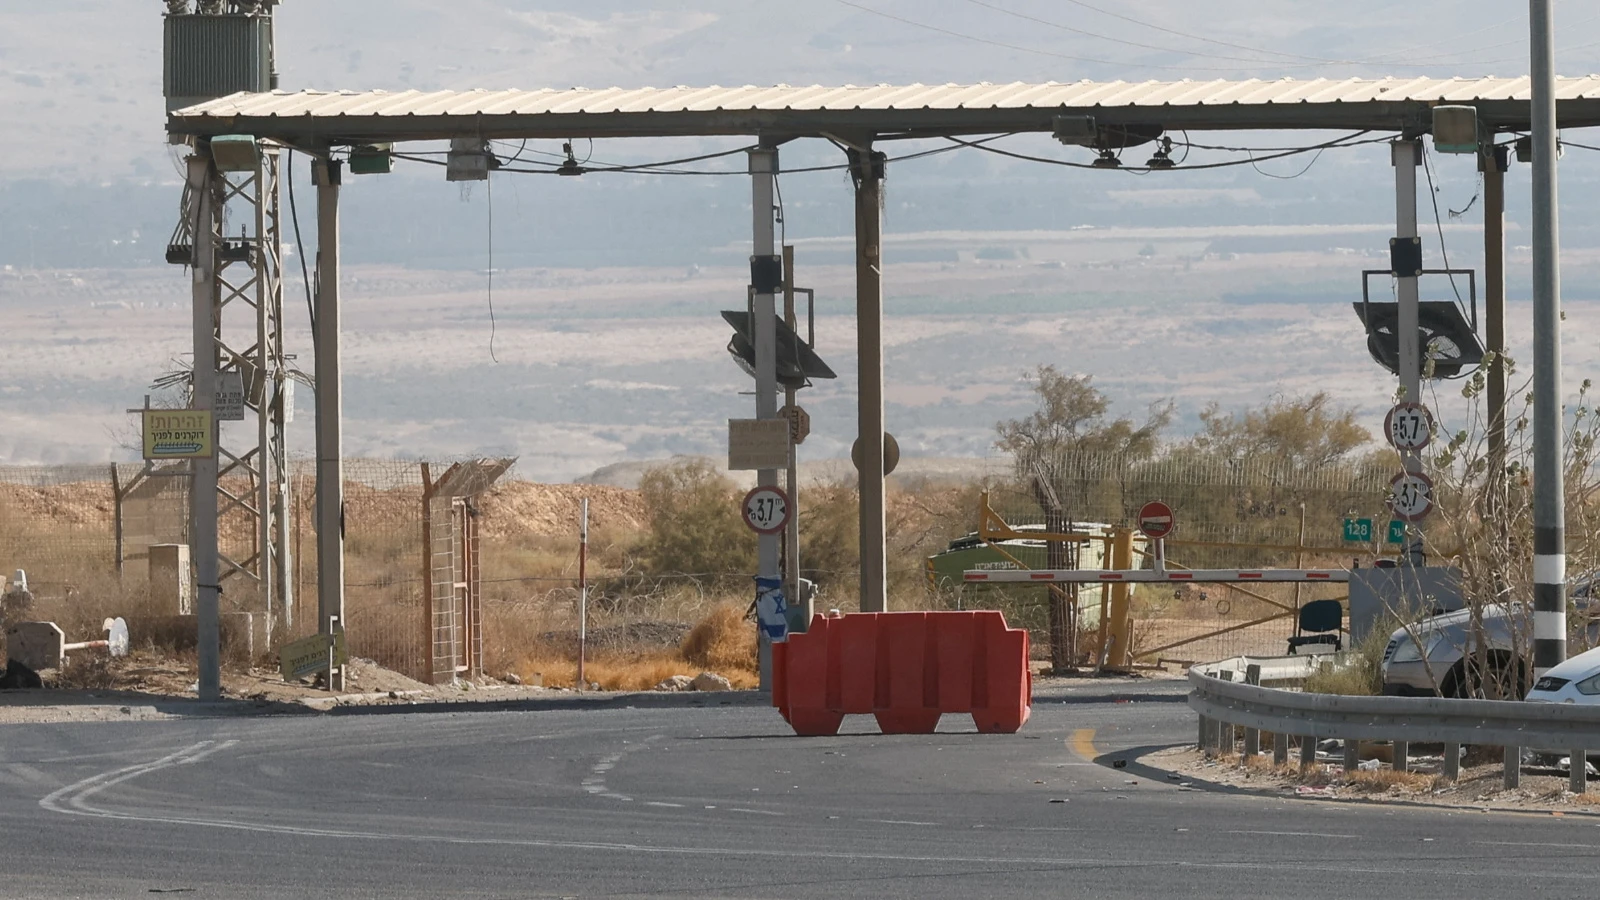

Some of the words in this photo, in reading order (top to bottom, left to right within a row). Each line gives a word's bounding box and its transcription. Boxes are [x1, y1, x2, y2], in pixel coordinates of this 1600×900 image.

[150, 415, 204, 429] זהירות!
[1399, 416, 1419, 440] 5.7
[151, 430, 173, 442] לפניך
[174, 431, 205, 441] דוקרנים
[1401, 483, 1418, 507] 3.7
[757, 498, 774, 522] 3.7
[1347, 524, 1368, 536] 128
